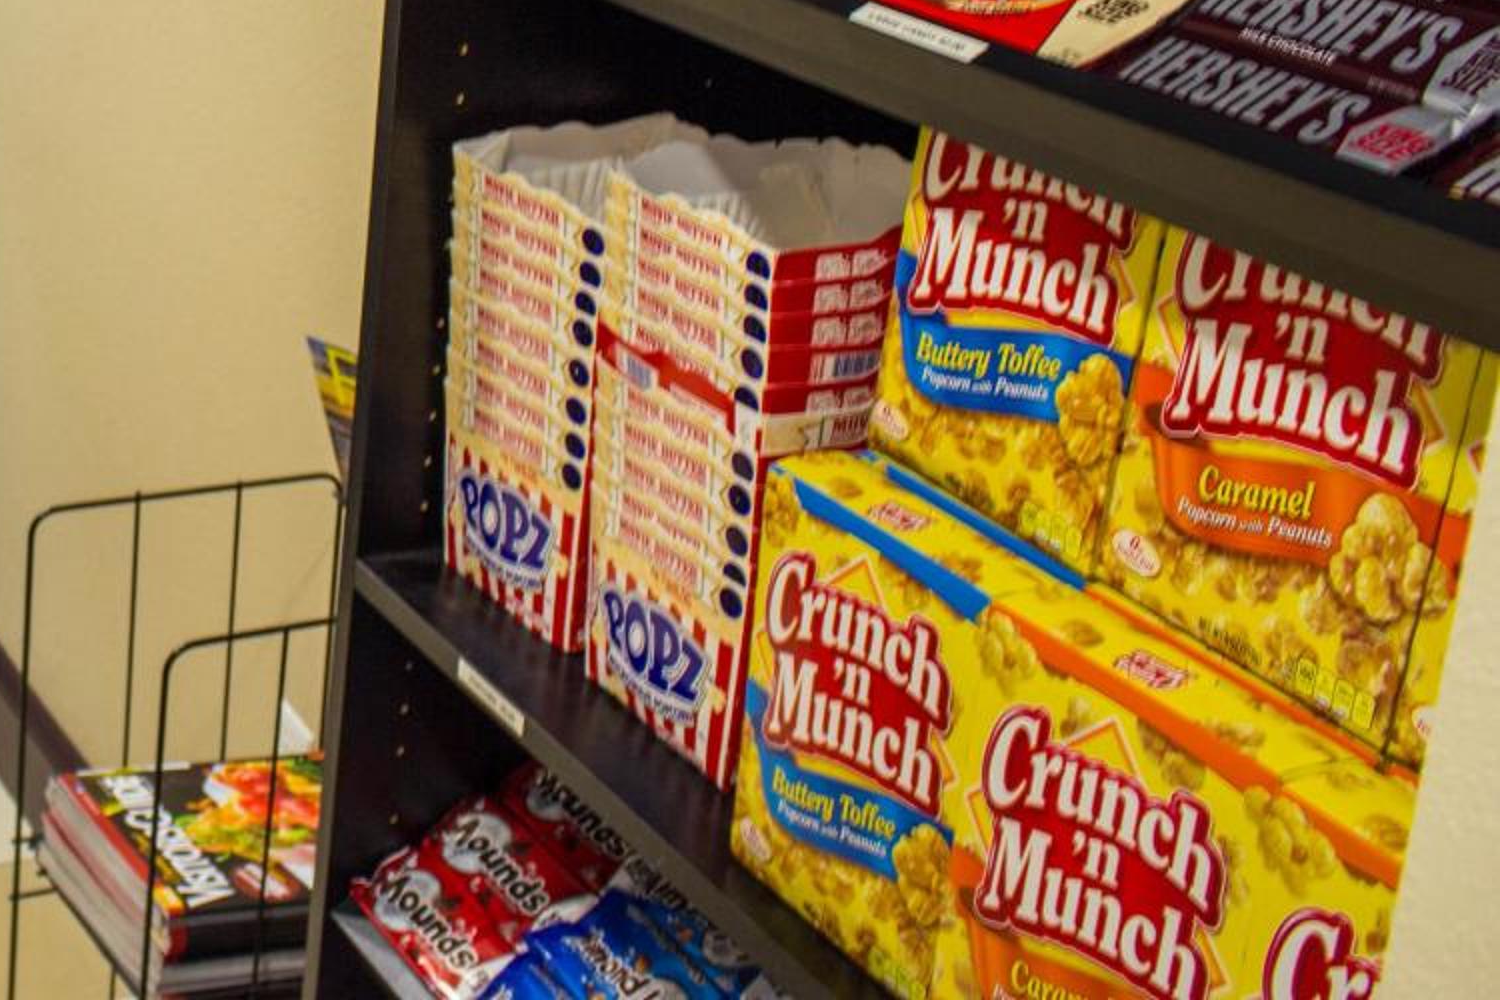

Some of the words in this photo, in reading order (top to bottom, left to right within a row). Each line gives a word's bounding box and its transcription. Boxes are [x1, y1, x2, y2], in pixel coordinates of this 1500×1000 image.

[1118, 36, 1372, 144] HERSHEY'S
[913, 207, 1110, 335] Munch
[915, 329, 991, 379] Buttery
[997, 342, 1062, 382] Toffee
[921, 366, 971, 390] Popcorn
[994, 375, 1049, 403] Peanuts
[1170, 317, 1411, 475] Munch
[461, 477, 550, 570] POPZ
[1177, 493, 1237, 531] Popcorn
[1267, 515, 1334, 549] Peanuts
[1199, 464, 1316, 520] Caramel
[604, 590, 704, 702] POPZ
[768, 558, 942, 719] Crunch
[768, 650, 933, 805] Munch
[772, 764, 835, 824] Buttery
[839, 792, 896, 842] Toffee
[987, 714, 1212, 914] Crunch
[982, 815, 1198, 1000] Munch
